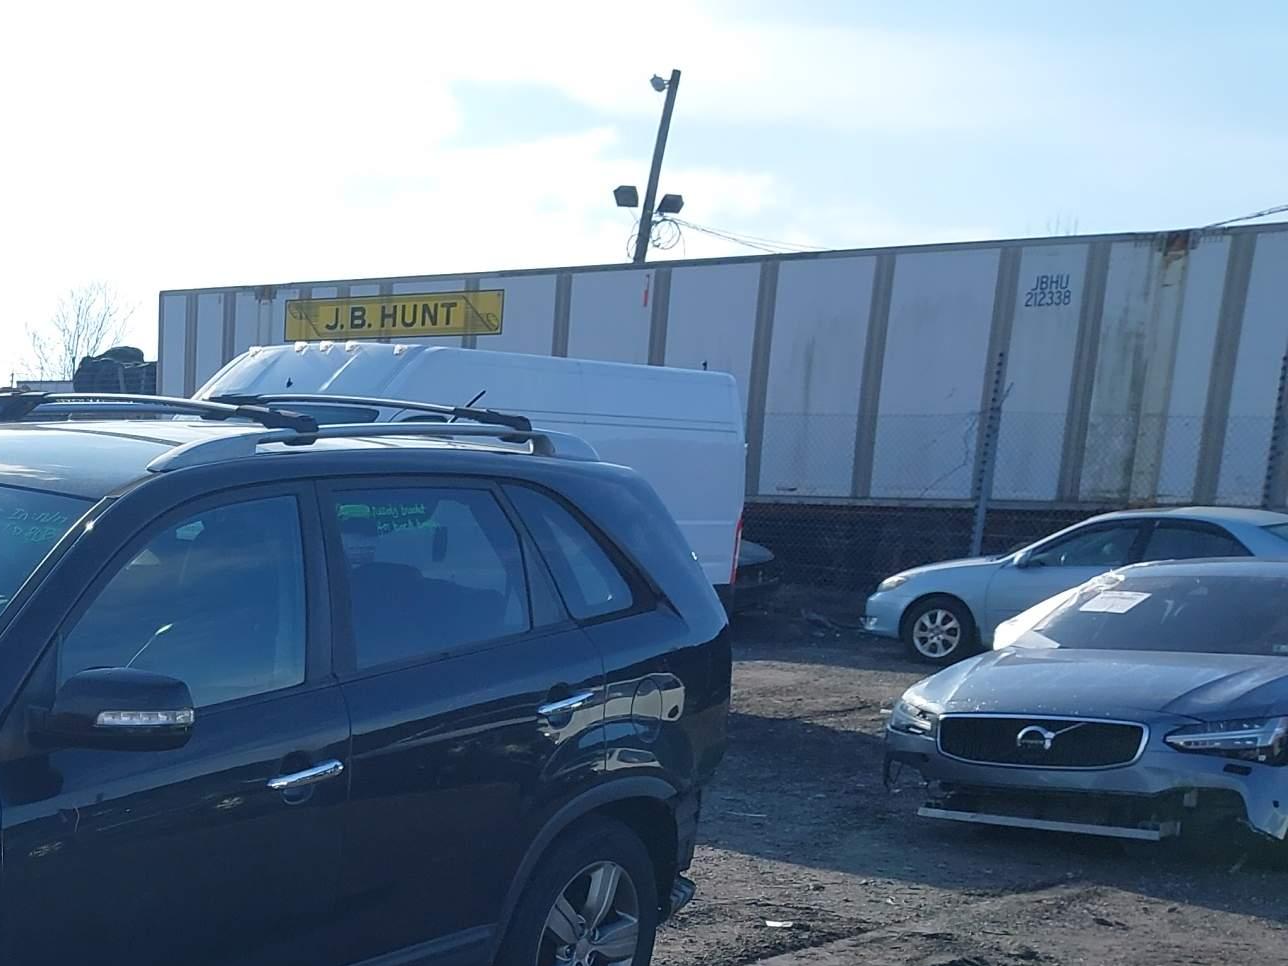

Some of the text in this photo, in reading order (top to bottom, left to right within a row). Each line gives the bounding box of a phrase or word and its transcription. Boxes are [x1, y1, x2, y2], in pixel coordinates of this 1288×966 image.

[1031, 274, 1070, 291] JBHU
[1024, 290, 1071, 307] 212338
[325, 302, 458, 330] J.B. HUNT
